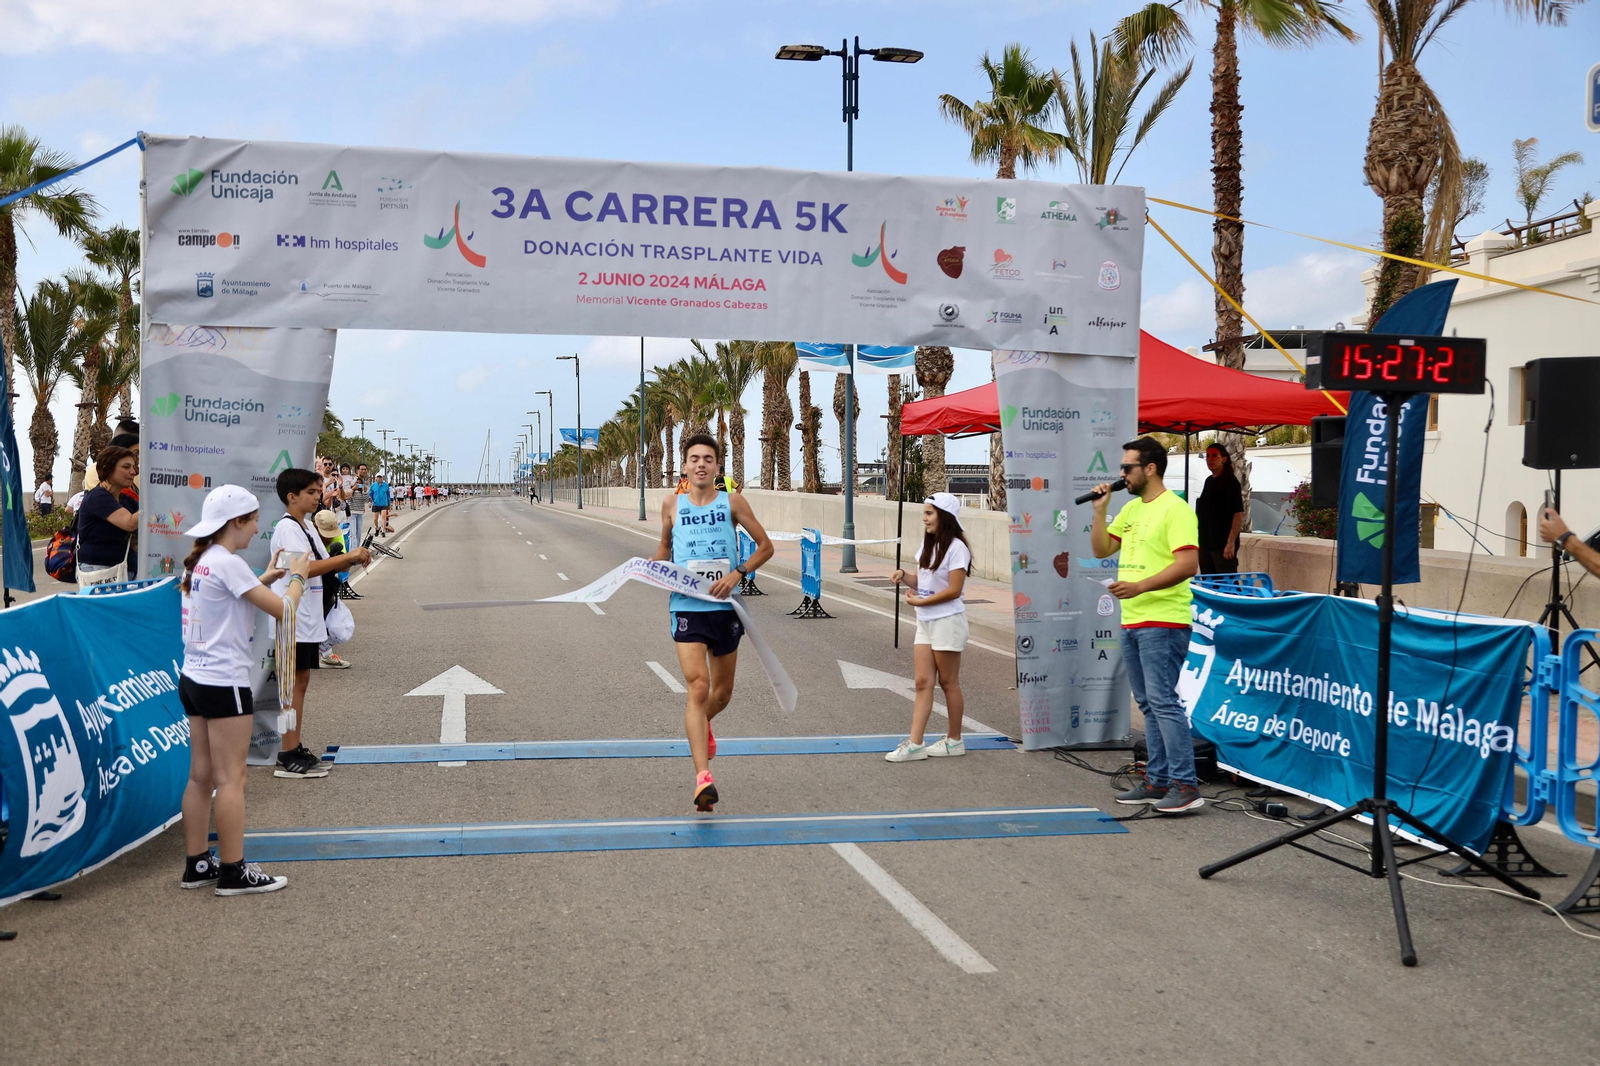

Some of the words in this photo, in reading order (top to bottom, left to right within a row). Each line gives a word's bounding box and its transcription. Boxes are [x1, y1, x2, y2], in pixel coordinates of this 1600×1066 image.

[211, 169, 299, 186] Fundación
[211, 185, 274, 203] Unicaja
[380, 202, 409, 211] persán
[490, 187, 552, 220] 3A
[564, 190, 782, 230] CARRERA
[794, 201, 849, 234] 5K
[1041, 211, 1077, 223] ATHEMA
[310, 236, 330, 249] hm
[335, 237, 399, 252] hospitales
[524, 238, 635, 258] DONACIÓN
[640, 244, 773, 264] TRASPLANTE
[778, 250, 824, 266] VIDA
[995, 269, 1021, 277] FETCO
[221, 279, 271, 289] Ayuntamiento
[452, 279, 477, 287] Trasplante
[578, 272, 588, 285] 2
[592, 272, 646, 287] JUNIO
[649, 274, 690, 289] 2024
[694, 273, 767, 291] MÁLAGA
[232, 288, 258, 297] Málaga
[576, 294, 624, 305] Memorial
[626, 296, 667, 307] Vicente
[670, 297, 721, 308] Granados
[724, 299, 768, 310] Cabezas
[1049, 306, 1063, 315] un
[1049, 325, 1059, 335] A
[185, 395, 264, 412] Fundación
[185, 408, 241, 427] Unicaja
[1022, 407, 1080, 420] Fundación
[278, 427, 306, 436] persán
[1022, 419, 1064, 434] Unicaja
[1356, 396, 1389, 484] Funda
[170, 443, 183, 452] hm
[185, 444, 225, 455] hospitales
[1026, 451, 1057, 460] hospitales
[681, 509, 726, 526] nerja
[147, 522, 169, 530] Deporte
[689, 526, 722, 535] ATLETISMO
[1101, 559, 1119, 568] ON
[622, 559, 678, 581] CARRERA
[682, 574, 701, 590] 5K
[643, 567, 681, 589] TRASPLANTE
[1017, 611, 1038, 619] FETCO
[1095, 630, 1112, 638] un
[1098, 650, 1108, 660] A
[266, 670, 277, 682] A
[1225, 658, 1372, 717] Ayuntamiento
[1416, 698, 1514, 760] Málaga
[1210, 699, 1259, 732] Área
[1262, 714, 1286, 738] de
[1289, 717, 1350, 757] Deporte
[131, 737, 158, 765] de
